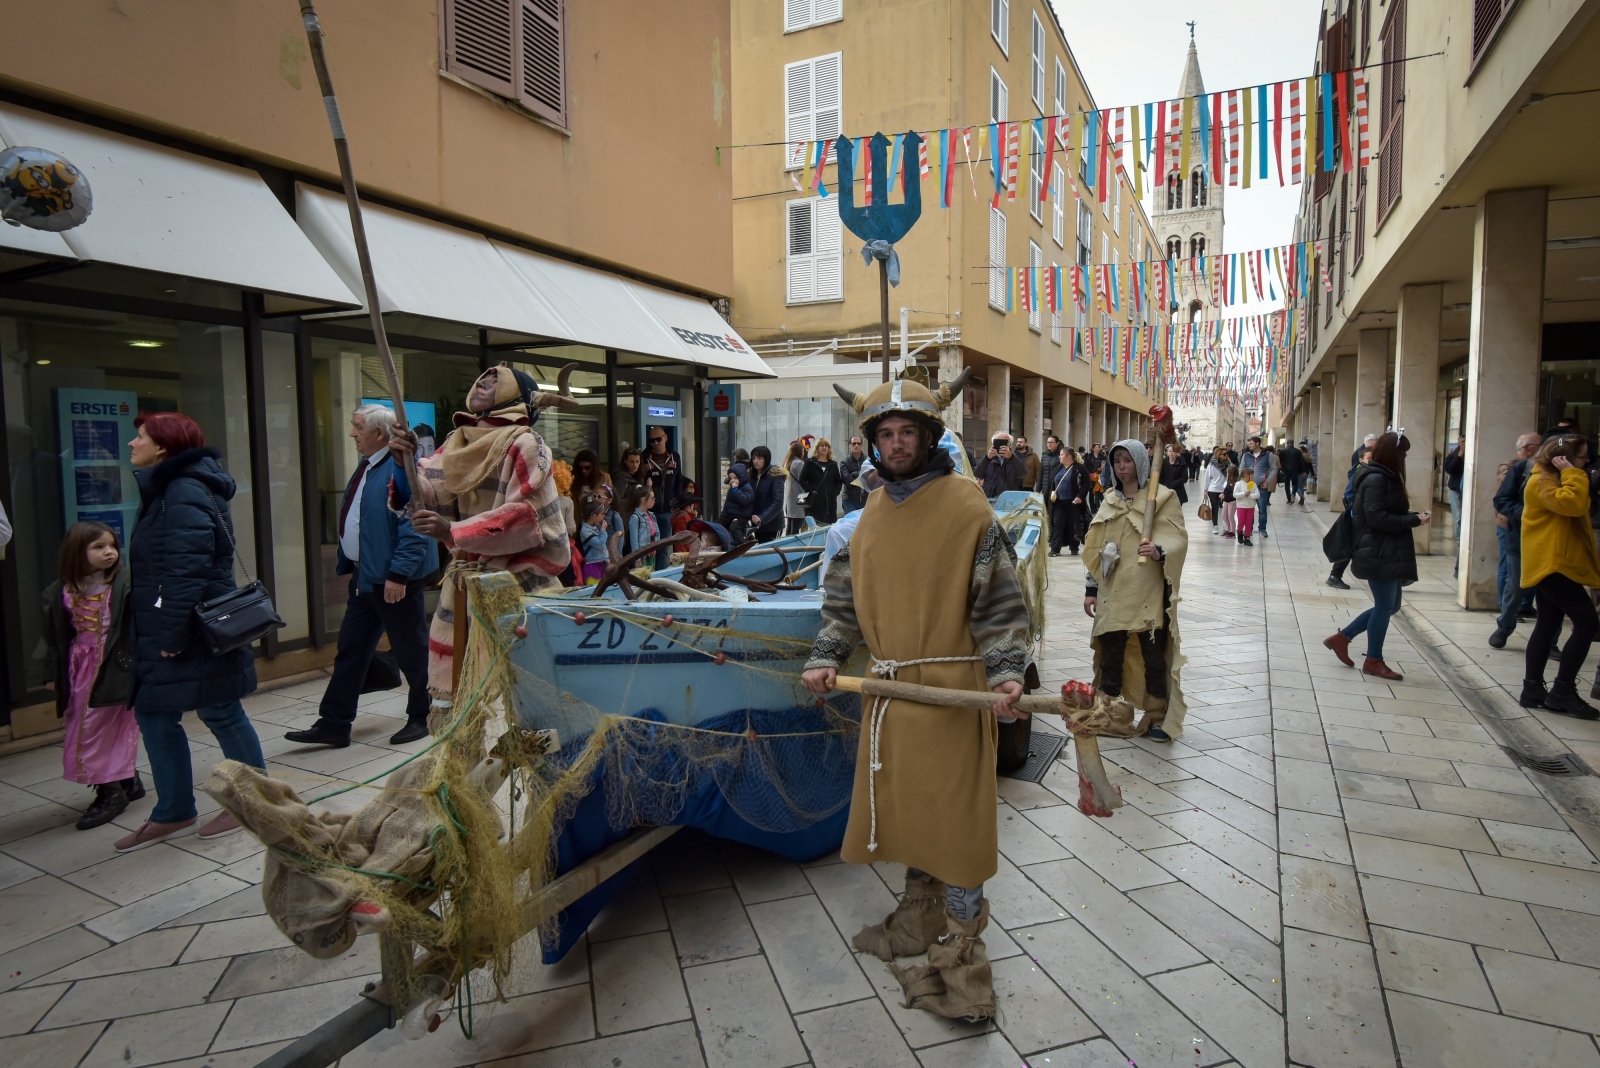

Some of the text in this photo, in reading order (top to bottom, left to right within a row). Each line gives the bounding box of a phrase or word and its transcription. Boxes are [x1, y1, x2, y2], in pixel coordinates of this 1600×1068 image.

[671, 326, 736, 352] ERSTE
[71, 402, 117, 415] ERSTE
[577, 617, 626, 650] ZD
